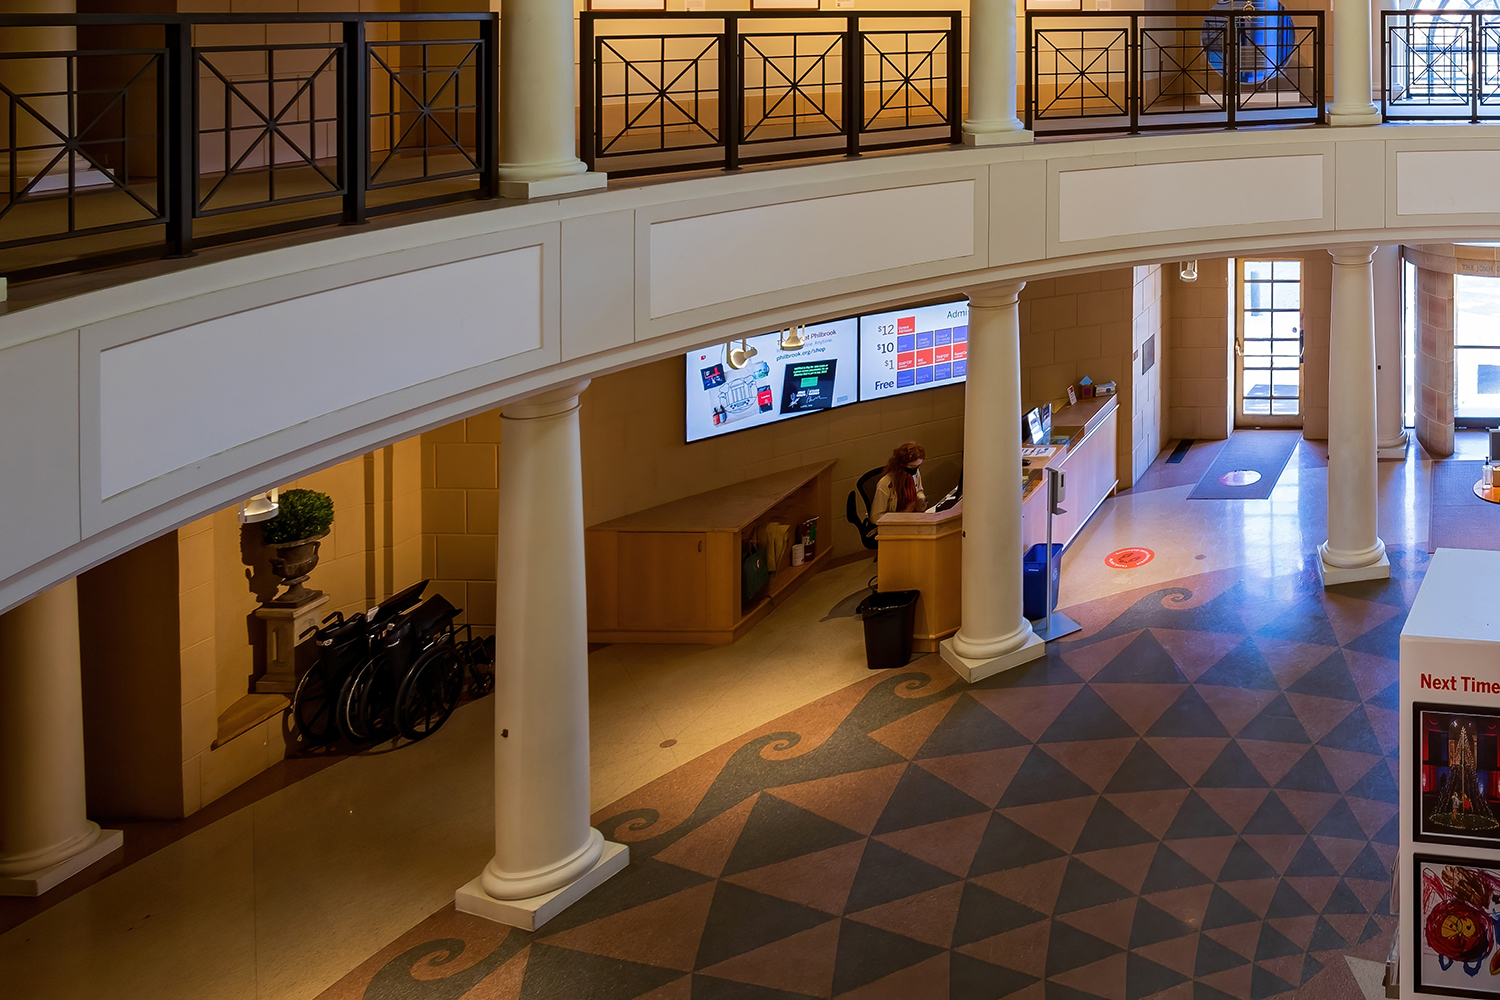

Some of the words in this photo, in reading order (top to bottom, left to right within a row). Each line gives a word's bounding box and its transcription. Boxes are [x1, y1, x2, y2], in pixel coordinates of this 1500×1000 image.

[810, 329, 837, 340] Philbrook
[877, 324, 895, 336] $12
[877, 342, 895, 354] $10
[776, 347, 827, 362] philbrook.org/shop
[884, 359, 894, 370] $1
[875, 380, 895, 391] Free
[1420, 673, 1457, 691] Next
[1460, 676, 1500, 694] Time
